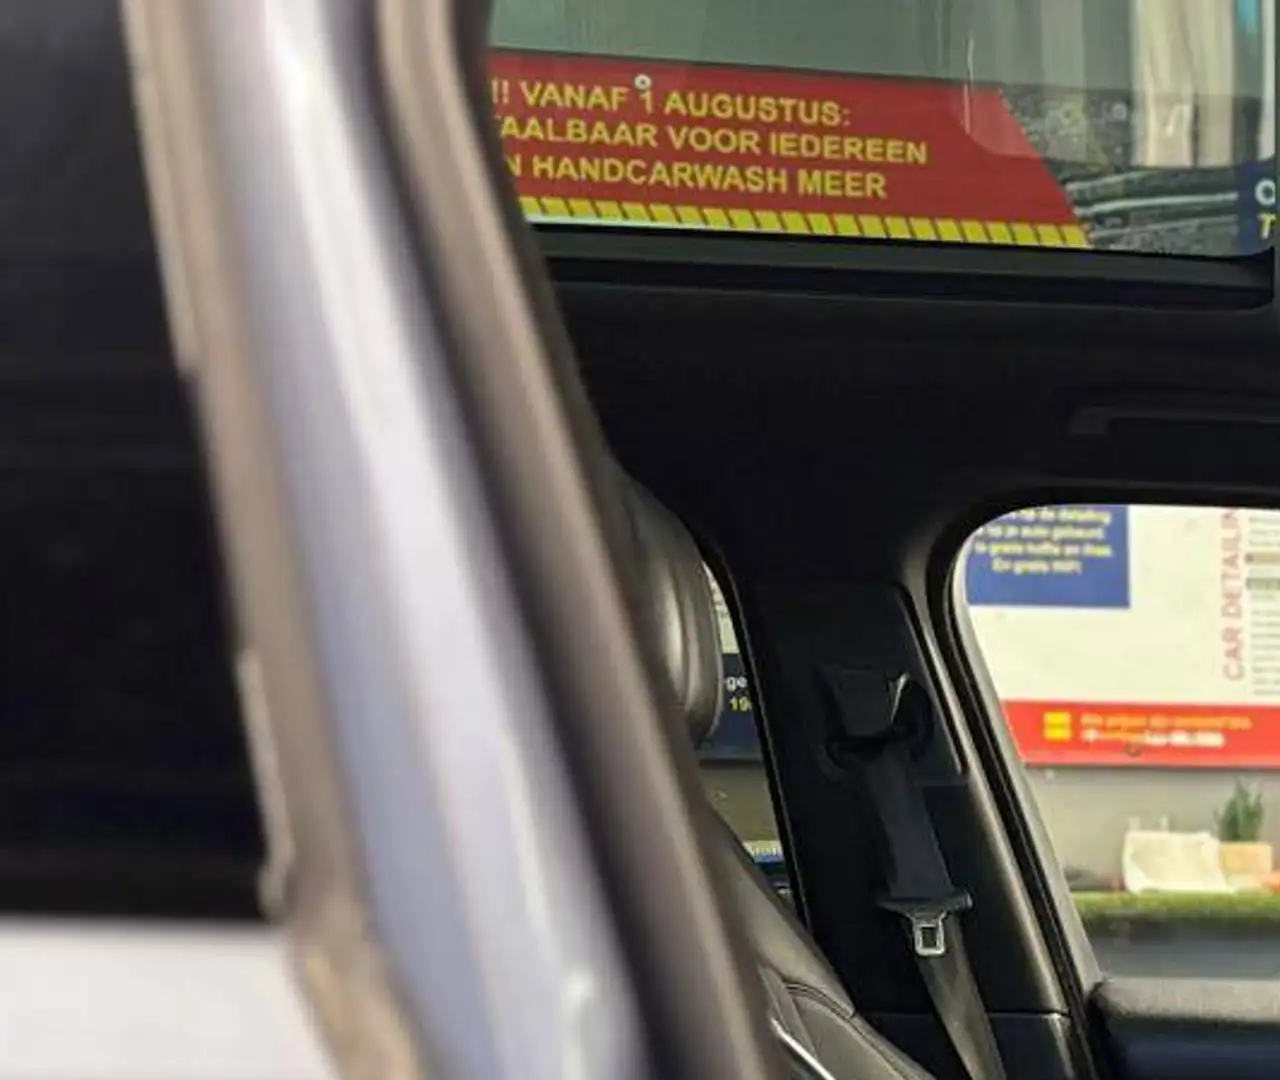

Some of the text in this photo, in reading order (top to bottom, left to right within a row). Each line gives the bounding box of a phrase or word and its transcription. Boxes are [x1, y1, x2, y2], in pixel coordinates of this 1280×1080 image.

[519, 80, 630, 112] VANAF
[664, 90, 852, 127] AUGUSTUS:
[495, 115, 928, 165] AALBAAR VOOR IEDEREEN
[532, 154, 788, 194] HANDCARWASH
[797, 168, 888, 200] MEER
